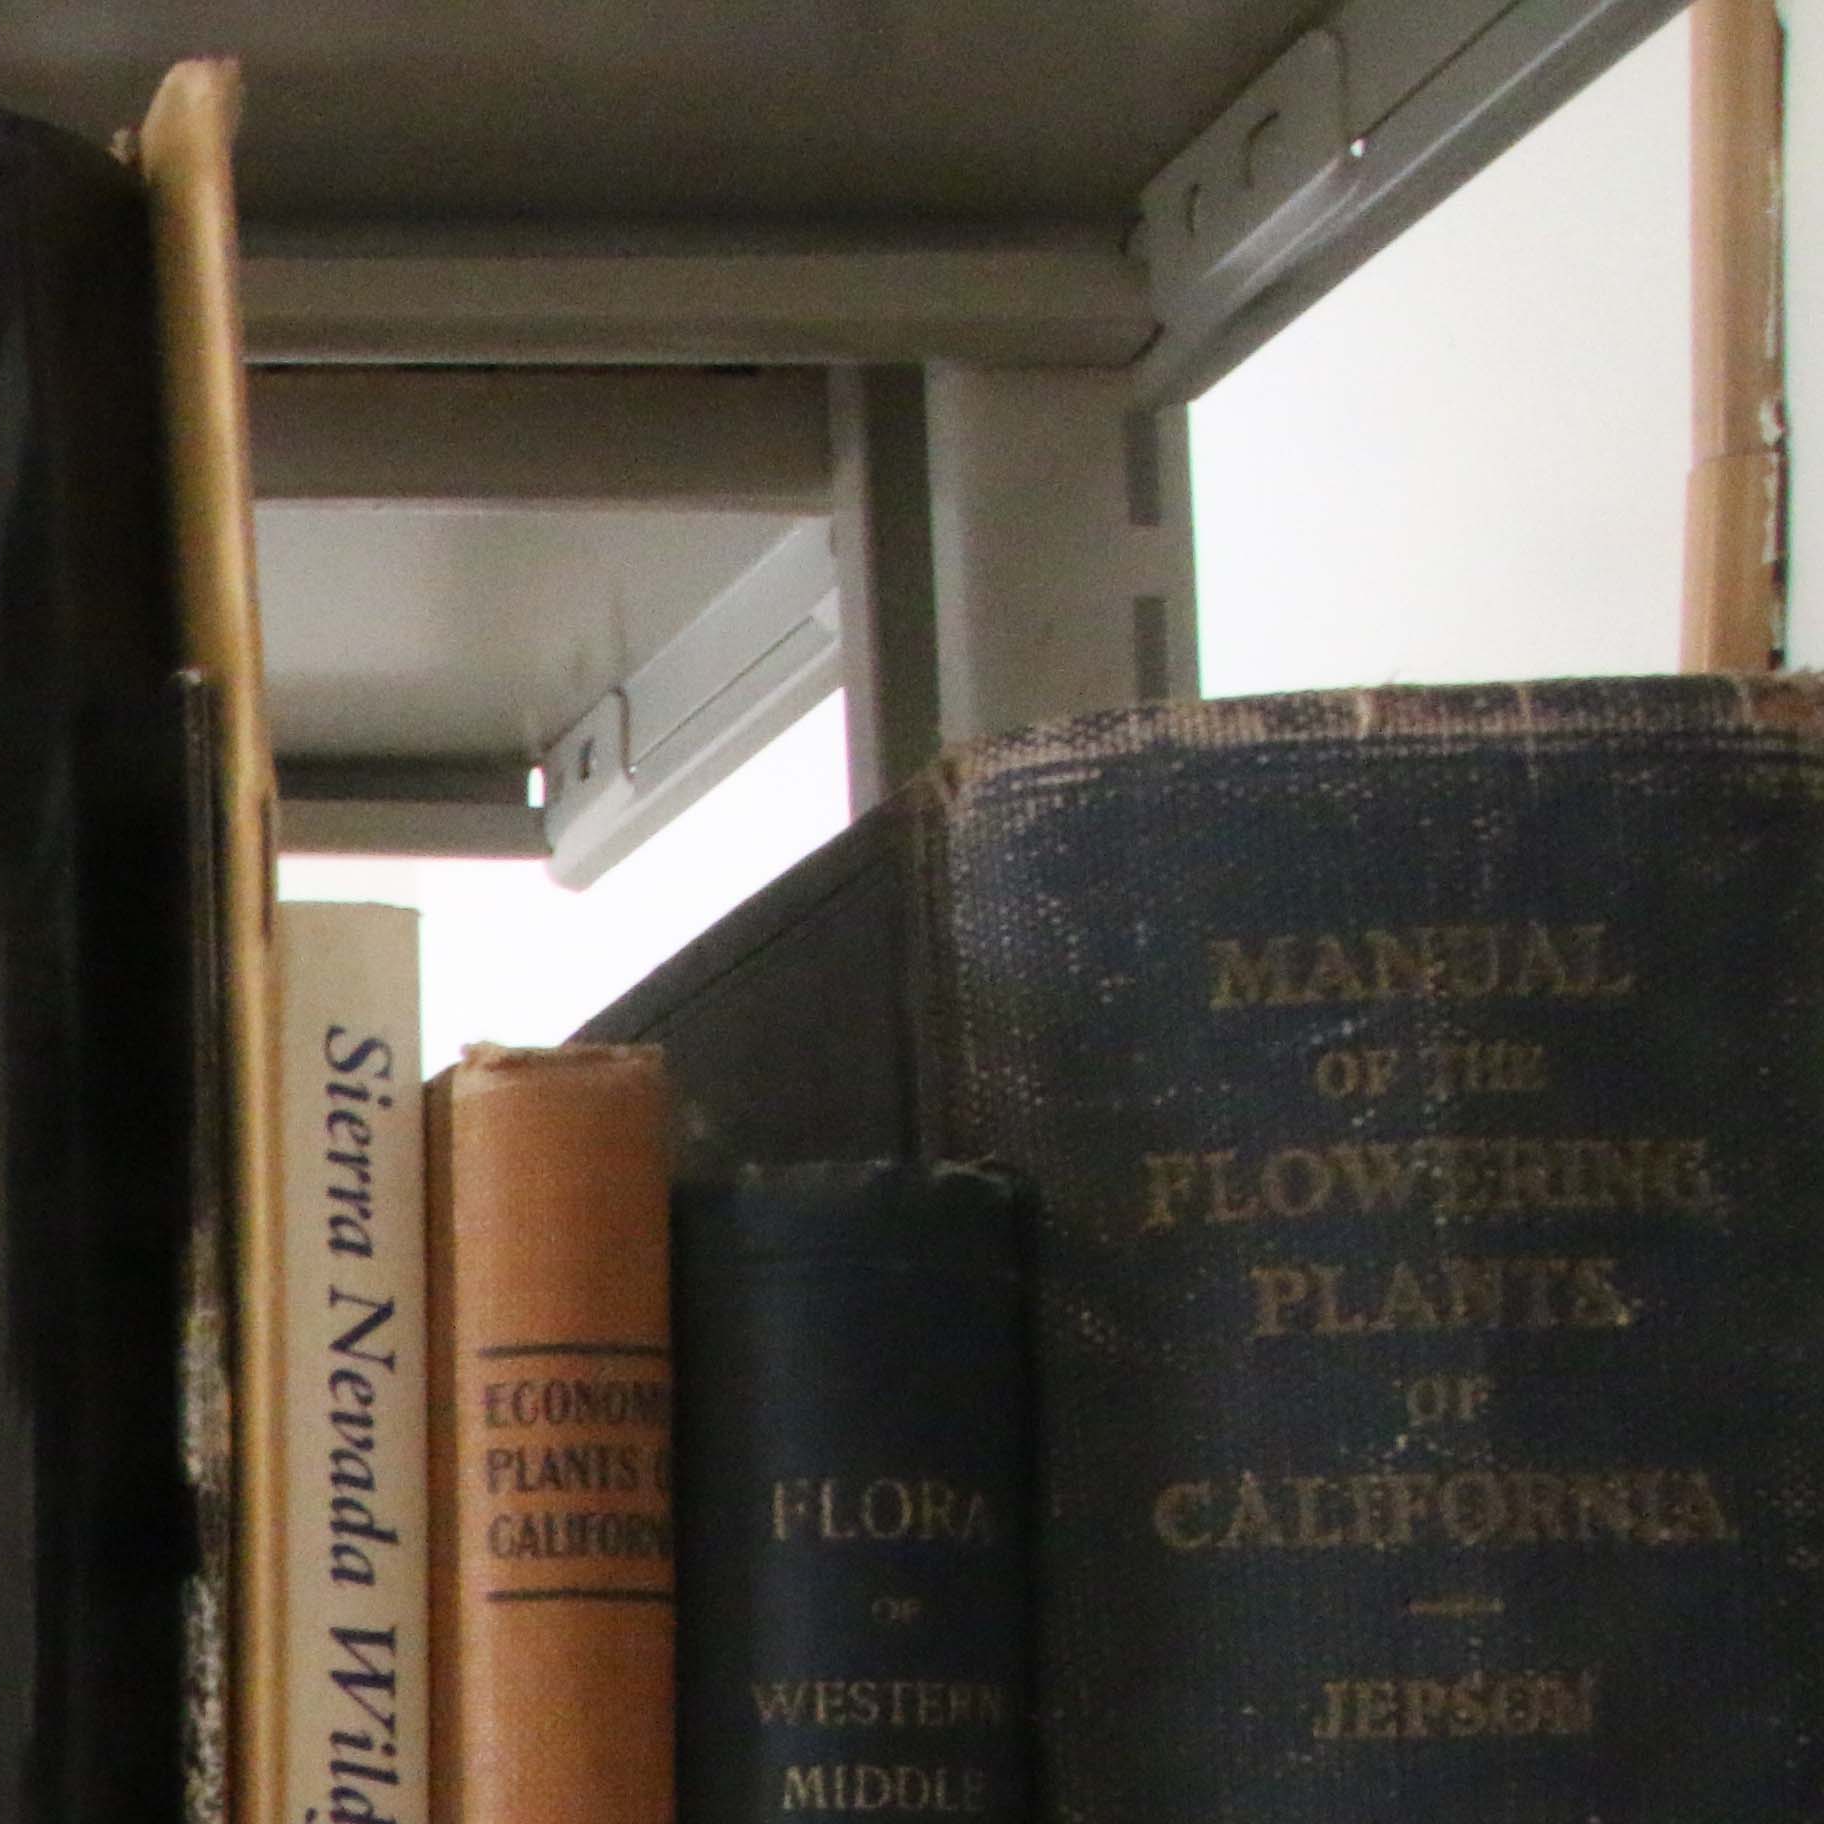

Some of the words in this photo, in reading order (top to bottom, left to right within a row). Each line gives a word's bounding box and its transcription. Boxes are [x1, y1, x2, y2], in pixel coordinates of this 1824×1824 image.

[1206, 922, 1637, 1013] MANUAL
[1316, 1045, 1400, 1099] OF
[324, 1025, 394, 1260] Sierra
[1144, 1137, 1732, 1234] FLOWERING
[1248, 1256, 1635, 1337] PLANTS
[328, 1284, 399, 1587] Nevada
[487, 1445, 639, 1492] PLANTS
[769, 1478, 993, 1541] FLORA
[1155, 1467, 1740, 1550] CALIFORNIA
[757, 1679, 1007, 1728] WESTERN
[1313, 1670, 1595, 1740] JEPSON
[782, 1765, 989, 1813] MIDDLE
